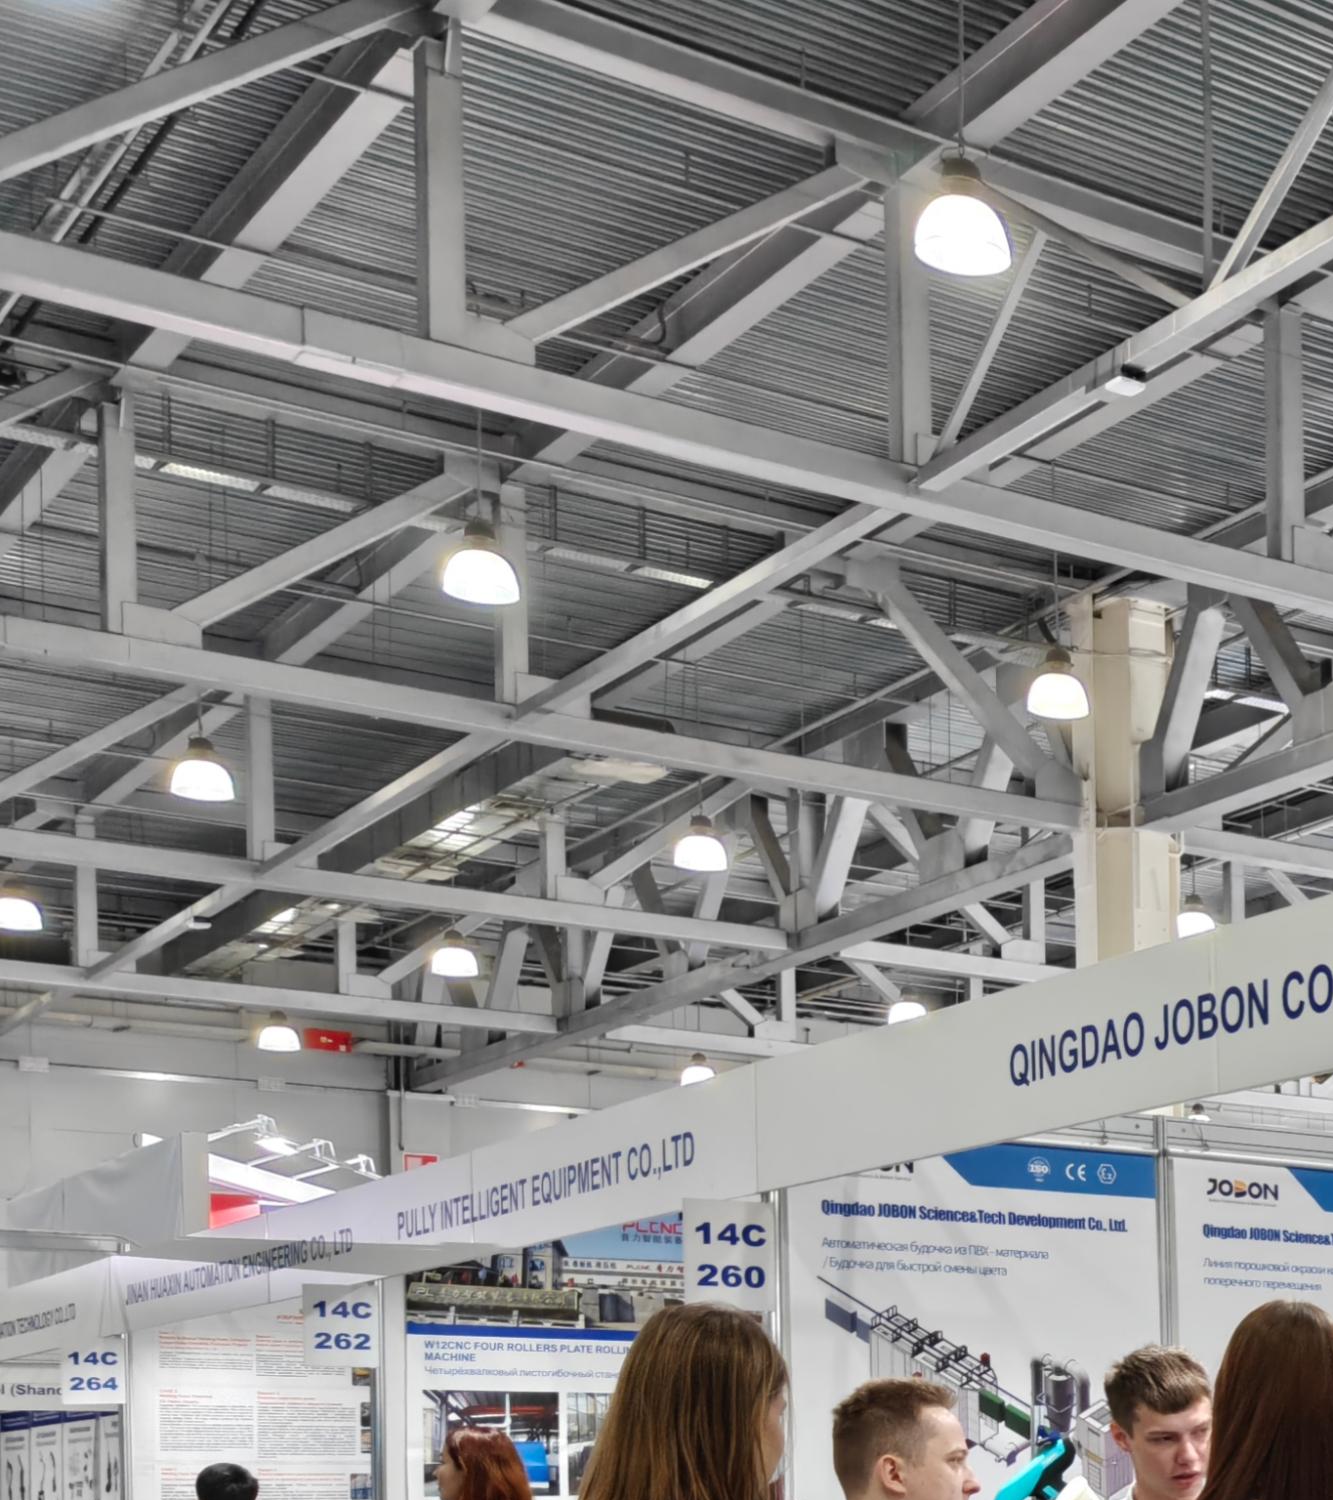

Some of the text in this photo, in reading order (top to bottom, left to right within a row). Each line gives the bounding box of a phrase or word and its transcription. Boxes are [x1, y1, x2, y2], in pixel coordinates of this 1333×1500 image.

[1009, 1011, 1145, 1087] QINGDAO
[1154, 979, 1269, 1050] JOBON
[397, 1130, 695, 1241] PULLY INTELLIGENT EQUIPMENT CO.,LTD
[1206, 1178, 1279, 1201] JOBON
[821, 1199, 875, 1219] Qingdao
[877, 1202, 916, 1219] JOBON
[918, 1205, 1006, 1226] Science&Tech
[1007, 1211, 1087, 1232] Development
[1108, 1218, 1128, 1234] Ltd.
[695, 1221, 767, 1248] 14C
[1202, 1223, 1248, 1241] Qingdao
[1249, 1226, 1281, 1243] JOBON
[821, 1235, 1050, 1261] Автоматическая будочка из ПВХ материала
[182, 1257, 241, 1294] AUTOMATION
[242, 1240, 308, 1279] ENGINEERING
[333, 1228, 353, 1256] LTD
[876, 1259, 895, 1273] для
[895, 1259, 943, 1275] быстрой
[943, 1264, 978, 1277] смены
[978, 1266, 1008, 1279] цвета
[1203, 1257, 1233, 1270] Линия
[1233, 1259, 1290, 1275] порошковой
[696, 1263, 766, 1289] 260
[1203, 1276, 1323, 1292] поперечного перемещения
[312, 1300, 372, 1320] 14C
[313, 1331, 372, 1351] 262
[424, 1339, 593, 1355] W12CNC FOUR ROLLERS PLATE
[67, 1351, 118, 1366] 14C
[424, 1351, 477, 1363] MACHINE
[69, 1376, 118, 1391] 264
